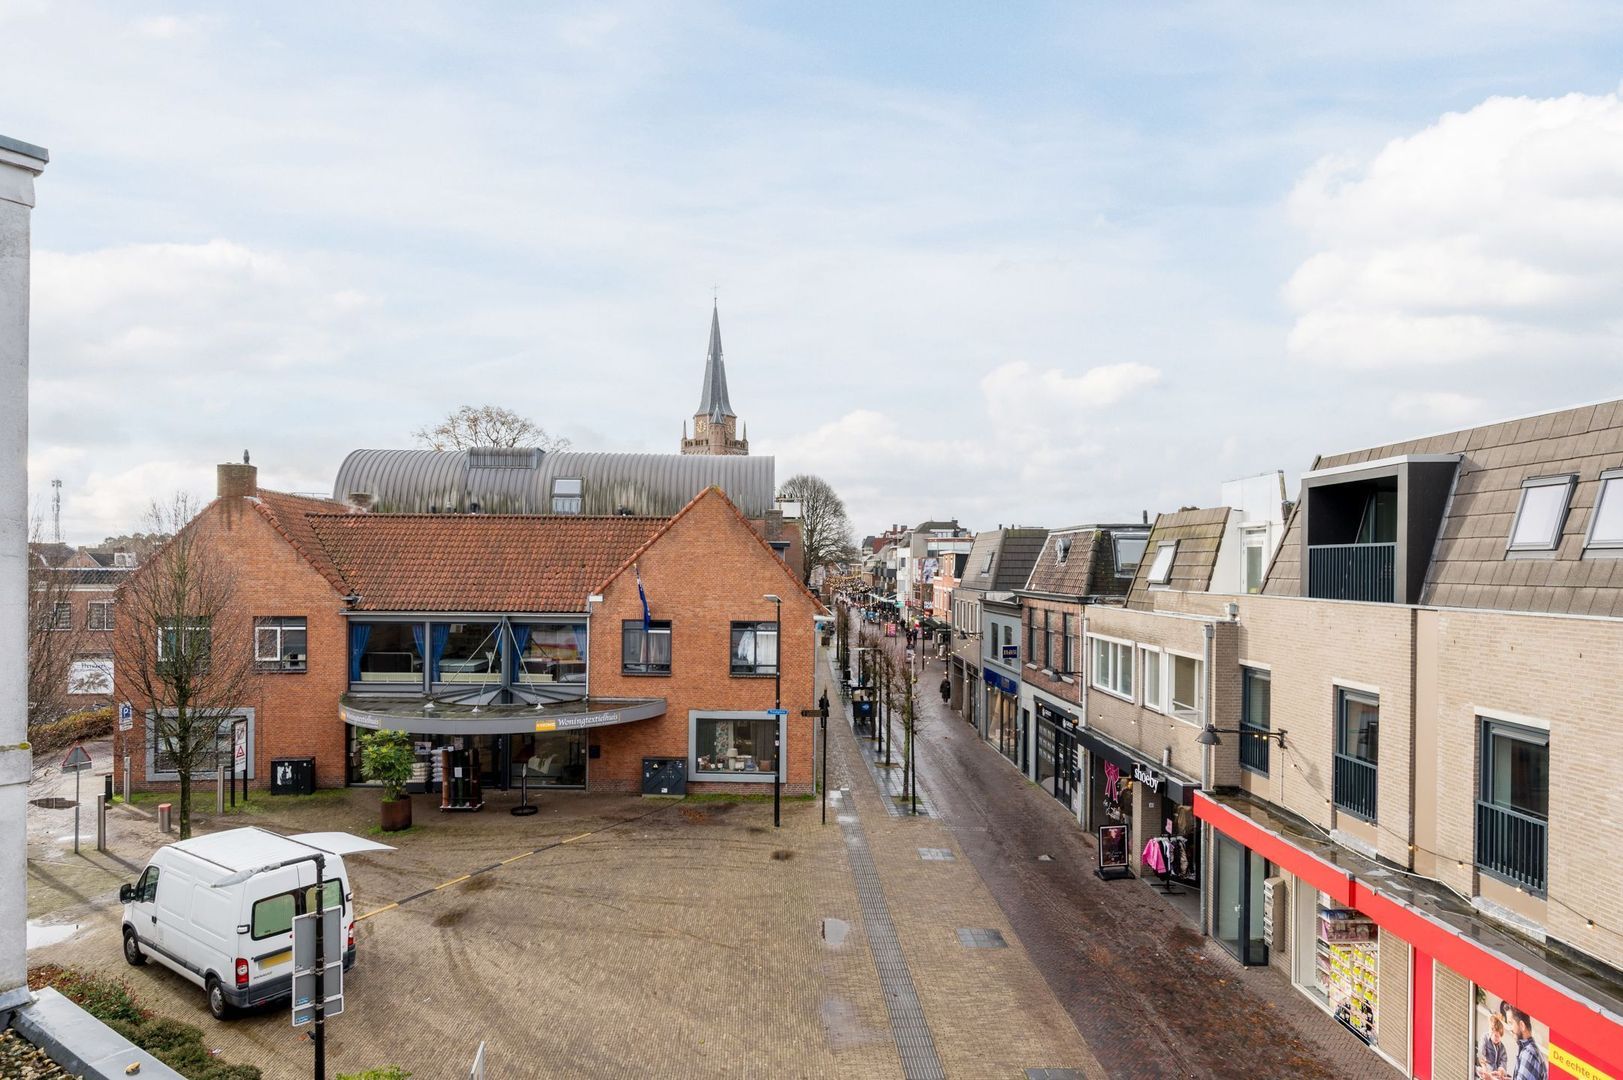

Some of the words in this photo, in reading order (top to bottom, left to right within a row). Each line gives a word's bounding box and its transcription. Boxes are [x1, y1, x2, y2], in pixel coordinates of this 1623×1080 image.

[558, 711, 618, 727] Woningtextielhuis
[1134, 764, 1158, 793] shoeby
[1553, 1050, 1563, 1063] De
[1565, 1059, 1591, 1079] echte
